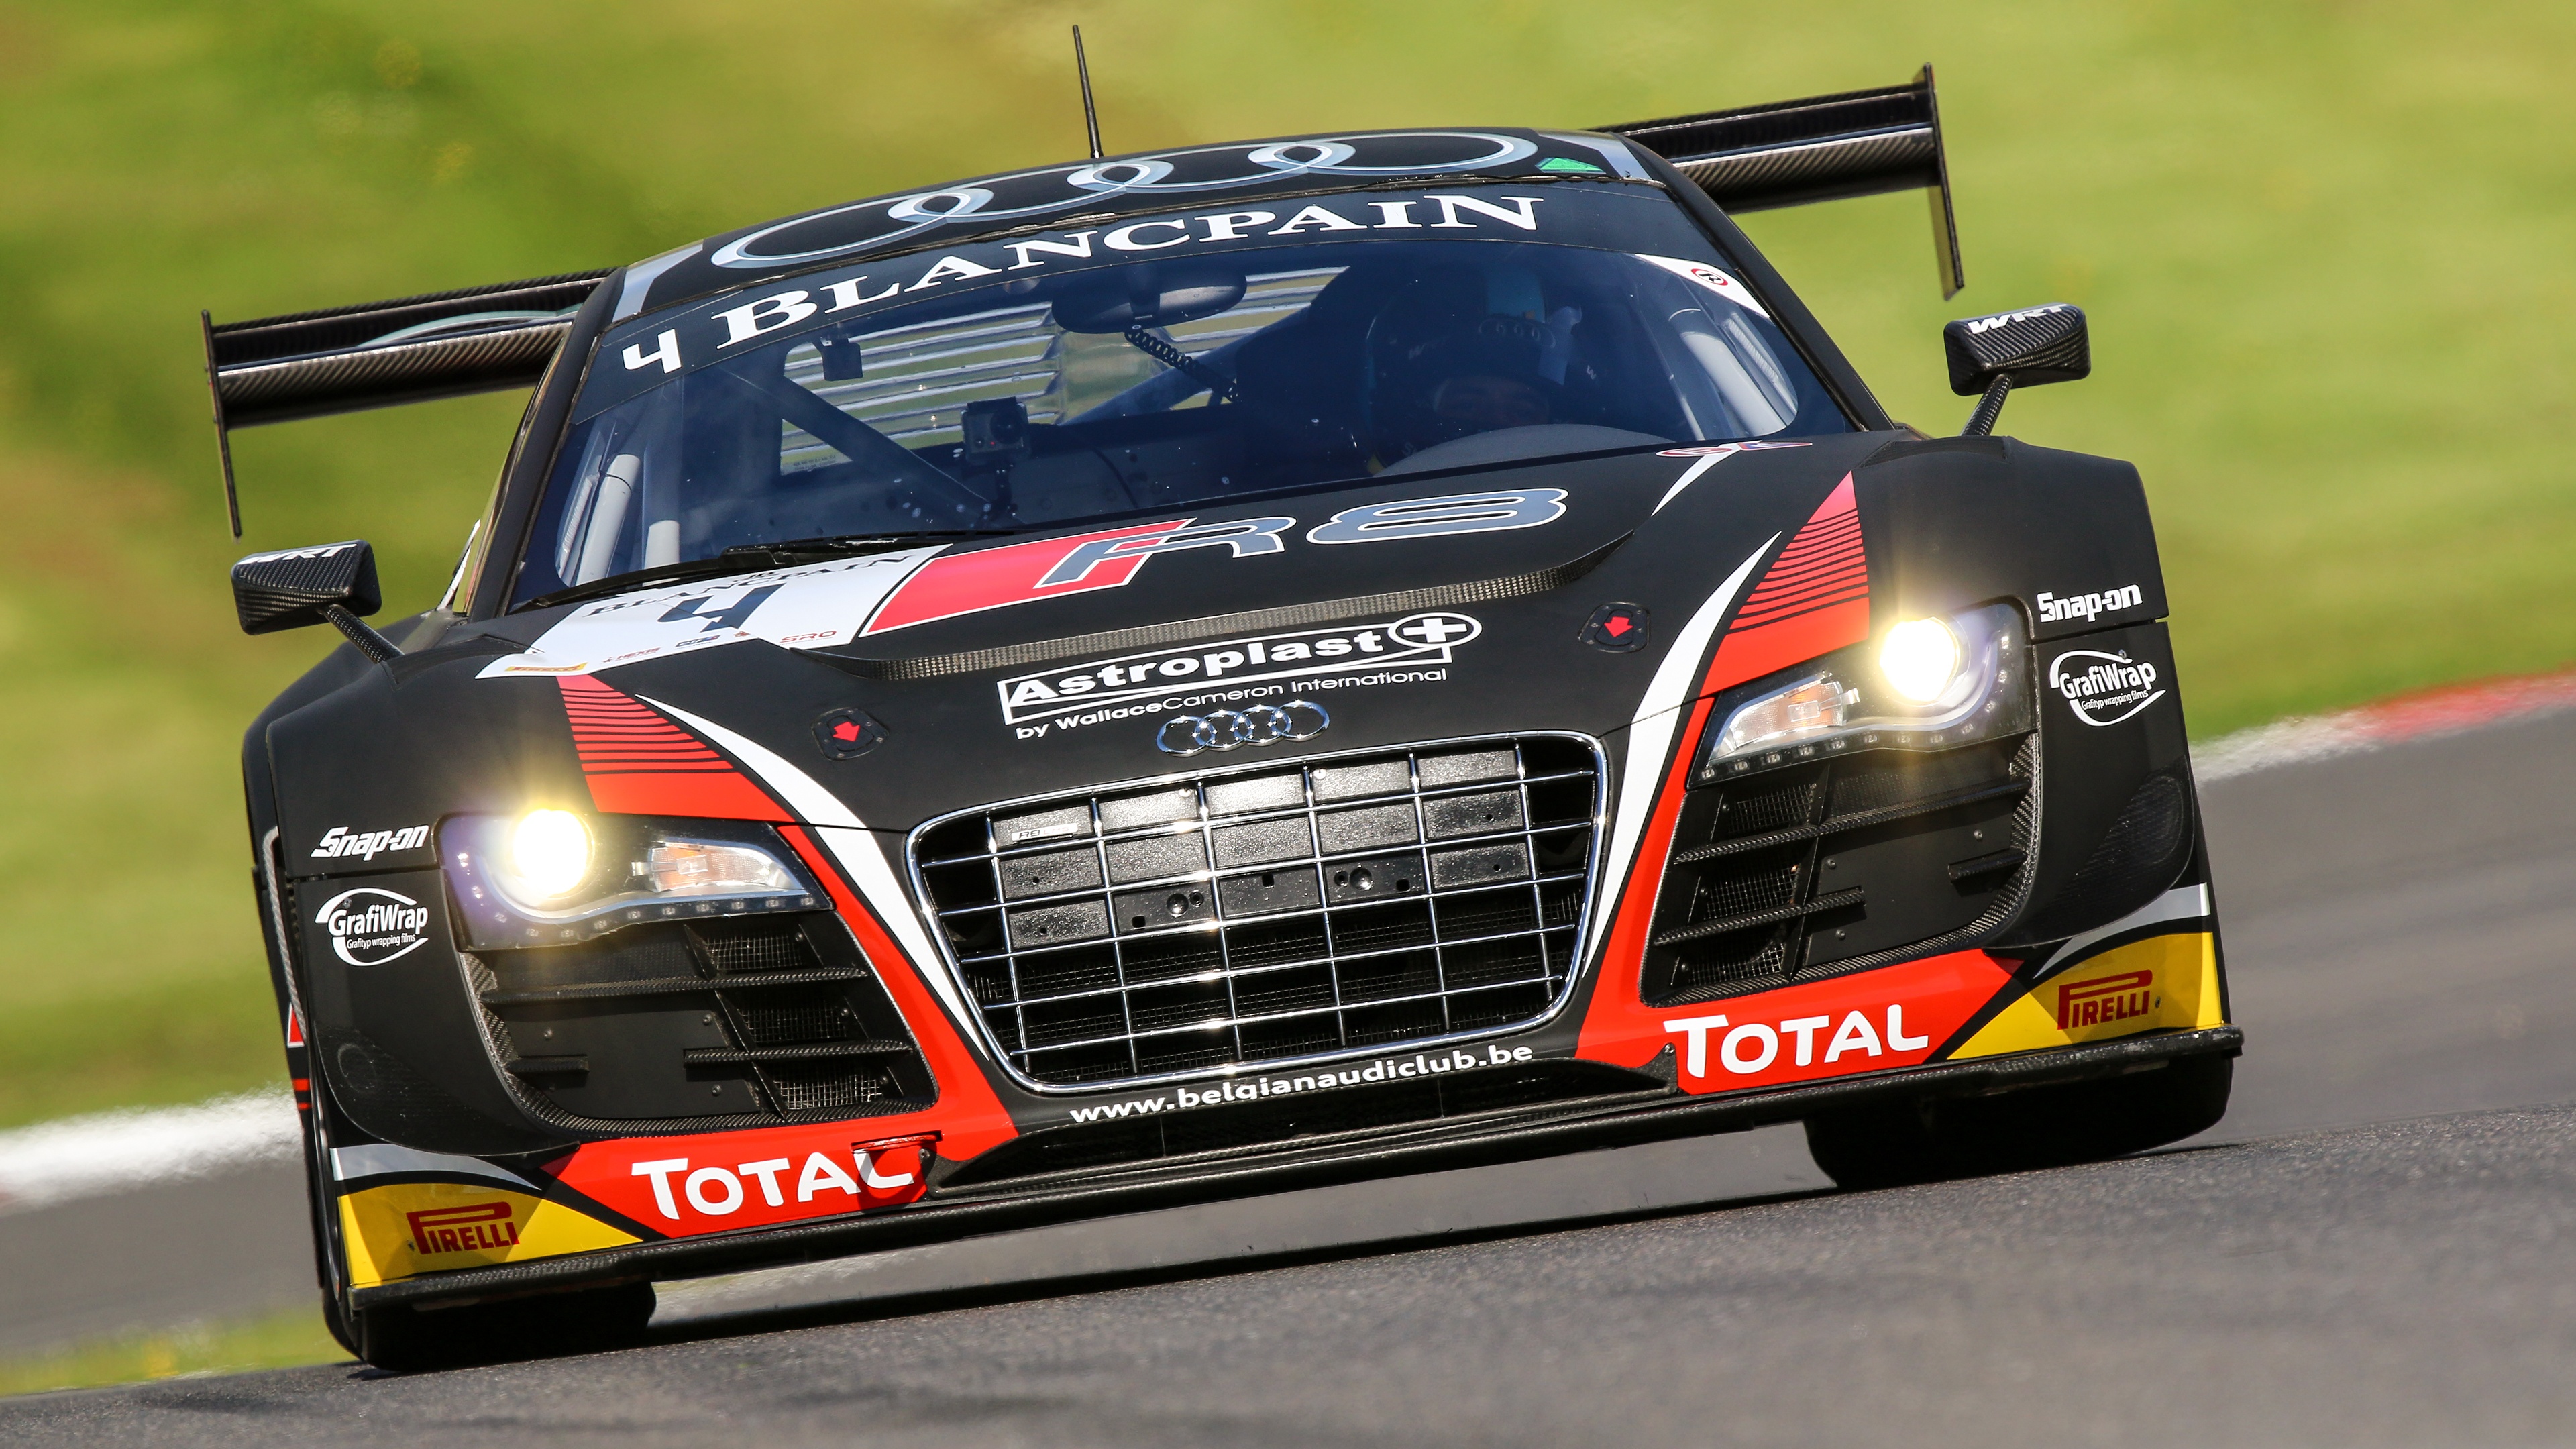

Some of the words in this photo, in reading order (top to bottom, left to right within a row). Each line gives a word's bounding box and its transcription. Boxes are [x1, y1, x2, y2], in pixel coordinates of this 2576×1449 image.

[621, 328, 682, 374] 4
[715, 195, 1544, 350] BLANCPAIN
[1968, 304, 2067, 335] WRT
[1033, 488, 1569, 589] R8
[582, 555, 916, 618] BLANCPAIN
[657, 582, 786, 633] 4
[2037, 584, 2143, 623] Snap-on
[780, 630, 837, 643] SRO
[1009, 630, 1386, 707] Astroplast
[2059, 662, 2157, 699] GrafiWrap
[1016, 722, 1050, 740] by
[1054, 683, 1284, 729] WallaceCameron
[1291, 668, 1447, 694] International
[2081, 698, 2104, 710] Grafityp
[2104, 693, 2133, 706] wrapping
[2131, 690, 2149, 700] films
[310, 824, 429, 861] Snap-on
[328, 904, 429, 936] GrafiWrap
[347, 938, 372, 950] Grafityp
[372, 934, 401, 947] wrapping
[400, 932, 416, 943] films
[2057, 969, 2153, 1030] PIRELLI
[1664, 1003, 1929, 1078] TOTAL
[1069, 1045, 1534, 1125] www.belgianaudiclub.be
[631, 1148, 915, 1220] TOTAL
[406, 1201, 520, 1255] PIRELLI
